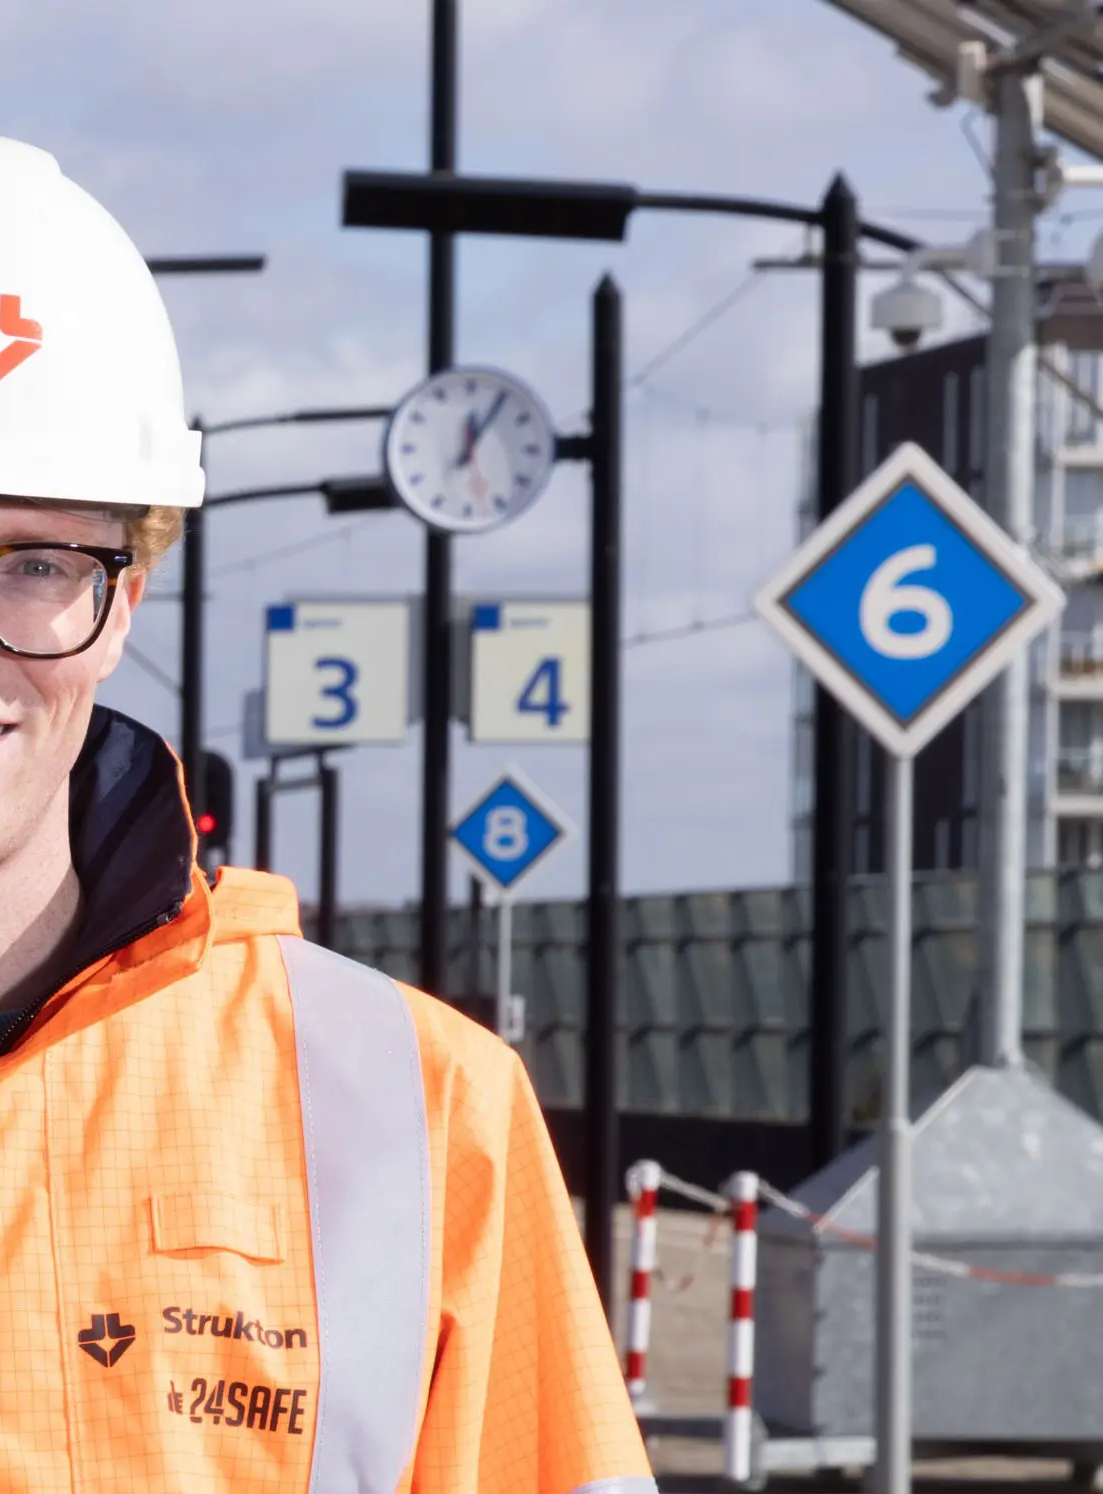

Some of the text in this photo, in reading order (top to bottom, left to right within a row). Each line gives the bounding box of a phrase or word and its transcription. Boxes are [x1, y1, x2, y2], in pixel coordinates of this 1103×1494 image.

[859, 543, 954, 660] 6
[310, 655, 360, 730] 3
[515, 655, 571, 728] 4
[483, 805, 529, 861] 8
[162, 1306, 308, 1349] Strukton
[189, 1377, 307, 1435] 24SAFE
